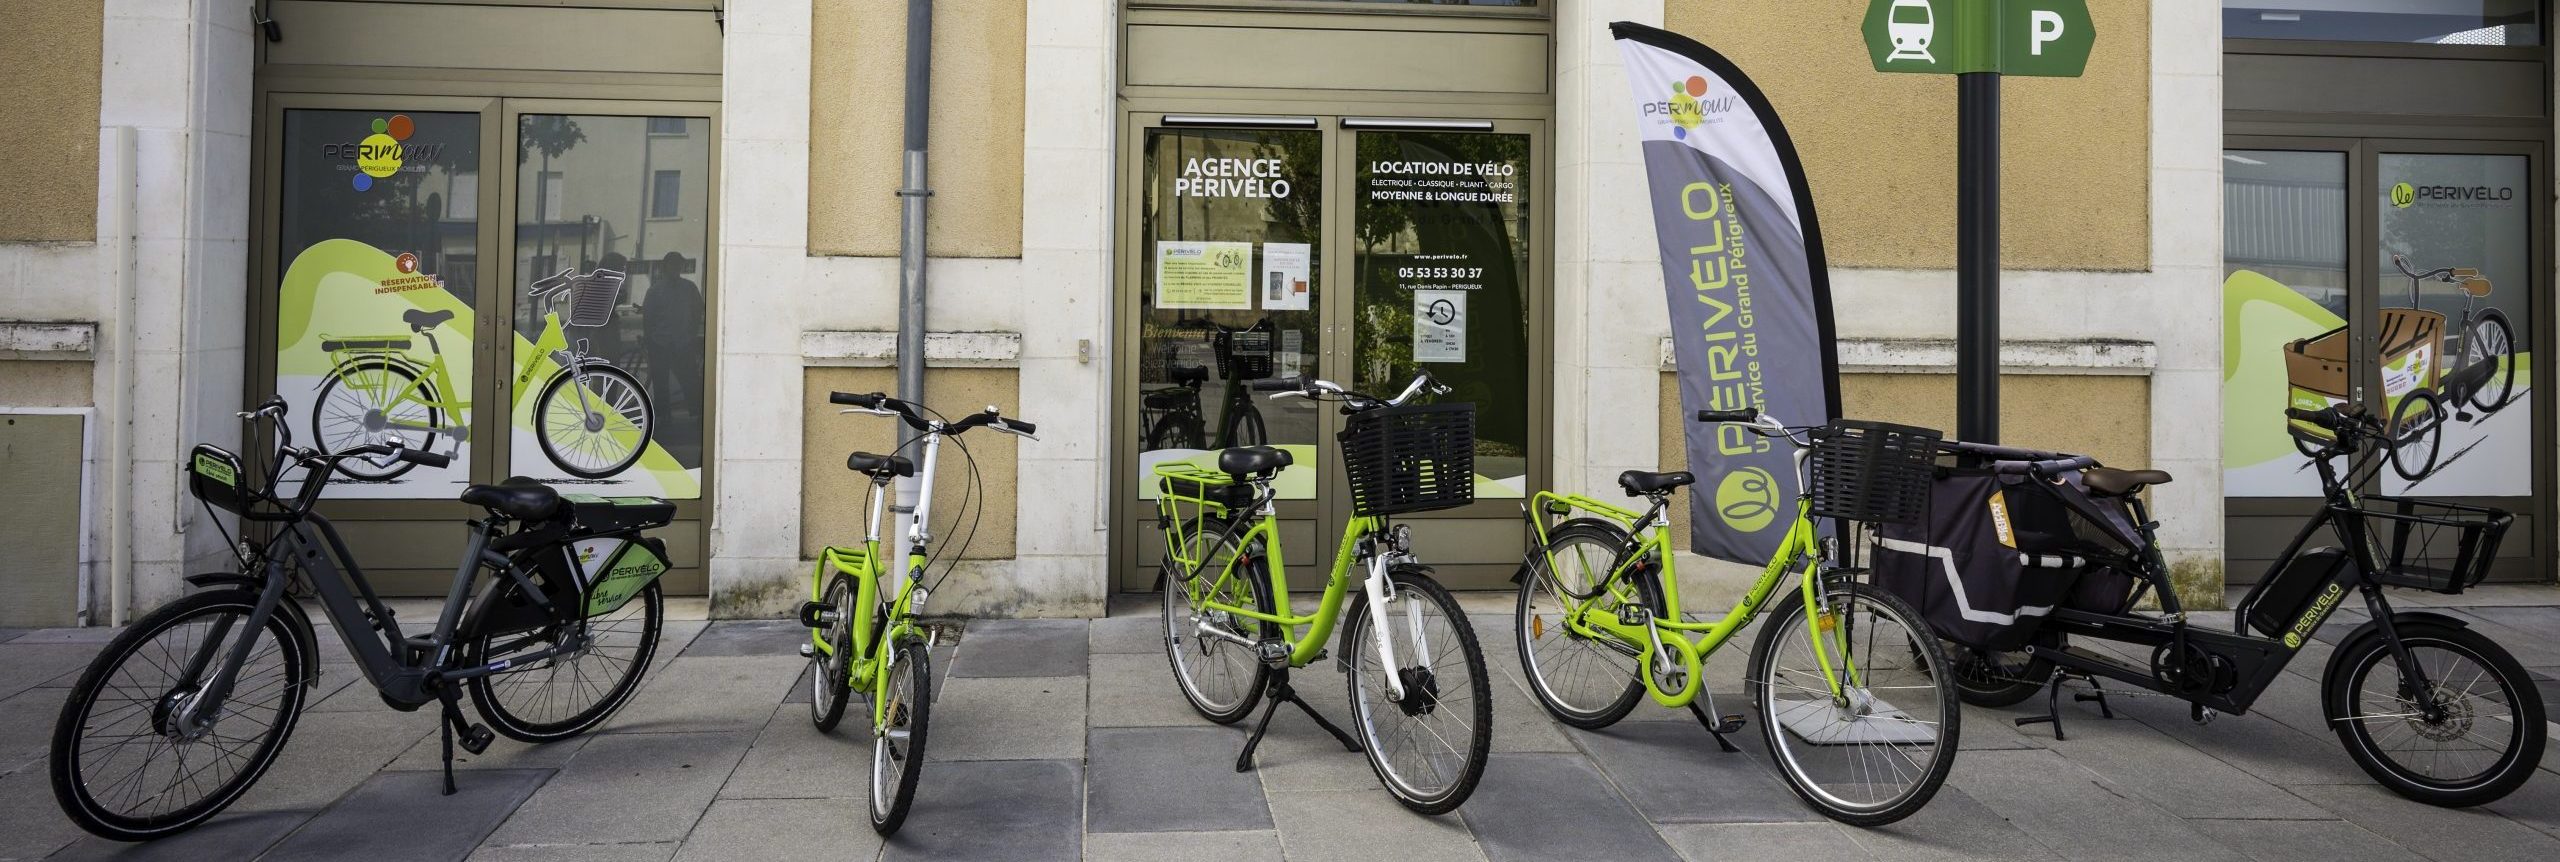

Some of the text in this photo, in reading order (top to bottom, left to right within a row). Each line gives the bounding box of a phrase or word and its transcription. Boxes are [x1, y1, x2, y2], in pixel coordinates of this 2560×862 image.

[2031, 10, 2064, 56] P
[1184, 157, 1282, 178] AGENCE
[1372, 160, 1513, 176] LOCATION DE VÉLO
[1175, 177, 1290, 199] PÉRIVÉLO
[1371, 178, 1413, 187] ÉLECTRIQUE
[1417, 180, 1455, 188] CLASSIQUE
[2418, 185, 2513, 201] PÉRIVÉLO
[1371, 190, 1513, 203] MOYENNE & LONGUE DURÉE
[1718, 182, 1747, 269] Périgueux
[381, 274, 437, 287] RÉSERVATION
[1398, 267, 1483, 279] 05 53 53 30 37
[1731, 273, 1753, 329] Grand
[1682, 182, 1752, 456] PÉRIVÉLO
[1741, 332, 1758, 357] du
[1746, 360, 1767, 417] ervice
